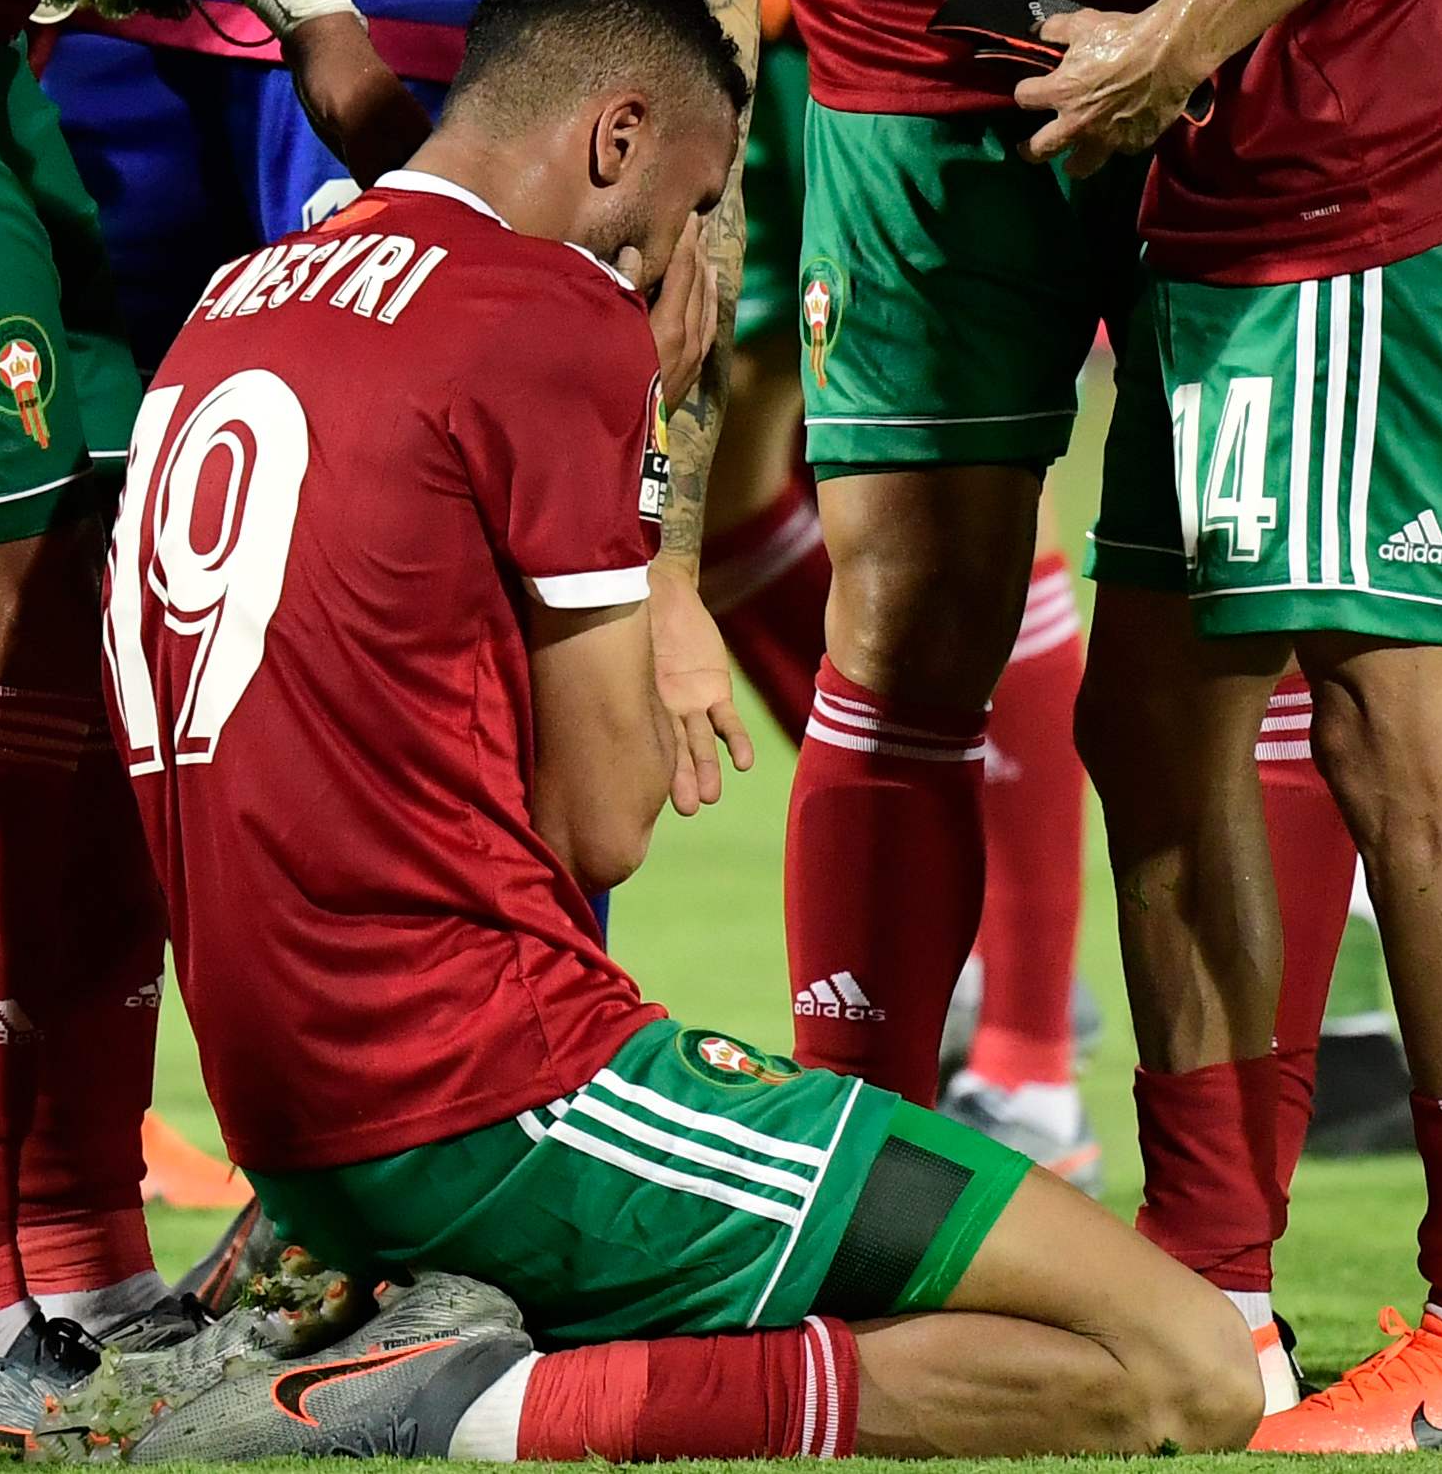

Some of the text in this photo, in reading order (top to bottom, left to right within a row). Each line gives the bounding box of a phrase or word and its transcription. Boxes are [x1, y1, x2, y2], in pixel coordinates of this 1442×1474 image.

[1172, 376, 1277, 570] 14
[103, 368, 310, 777] 19
[794, 1001, 887, 1022] adidas
